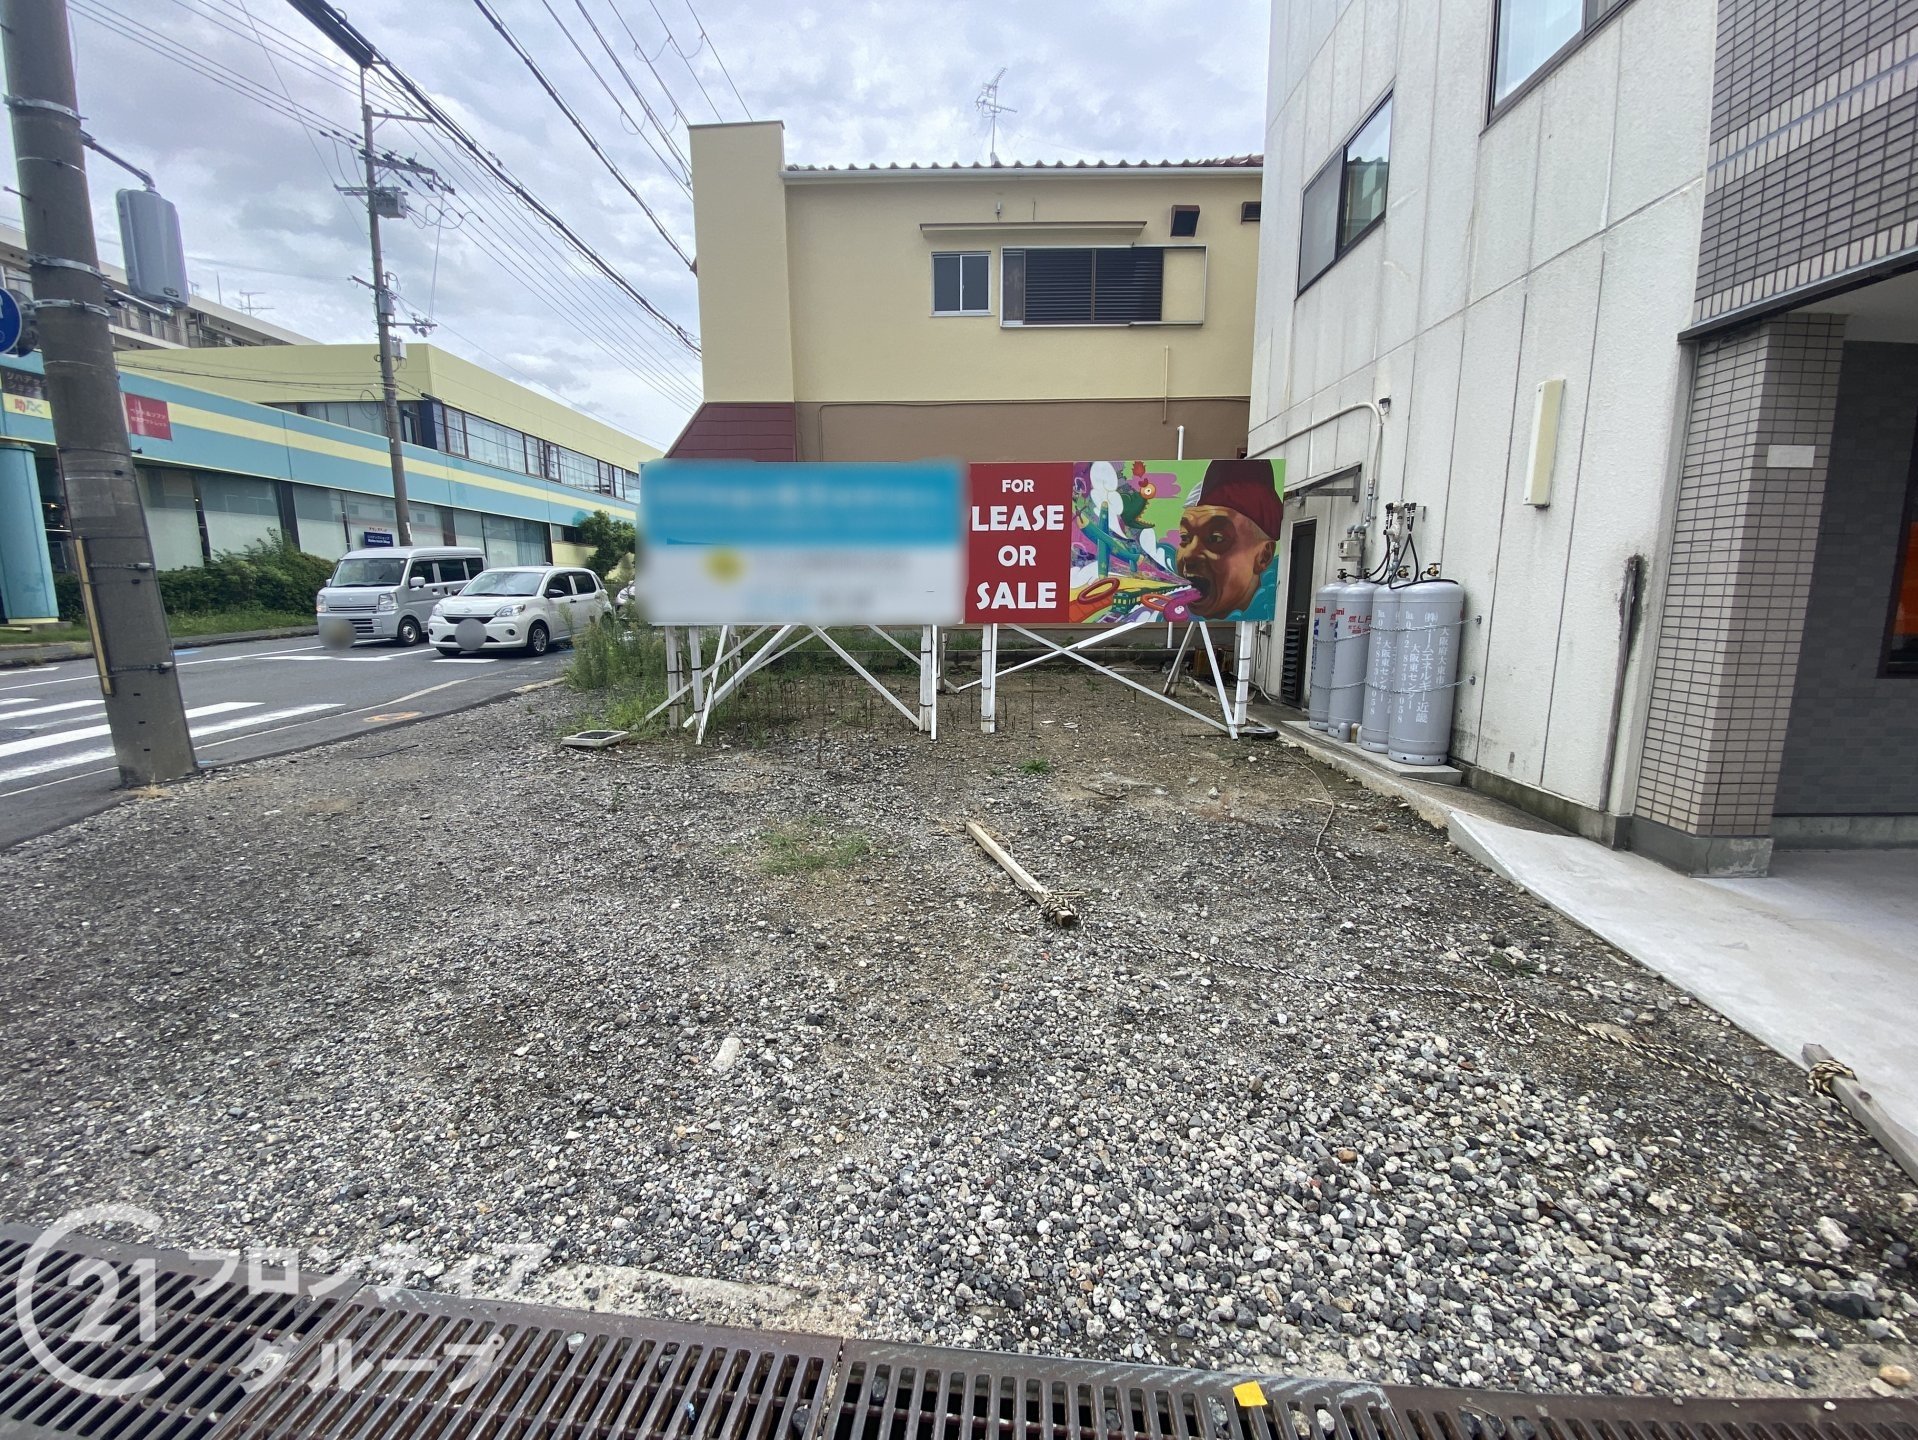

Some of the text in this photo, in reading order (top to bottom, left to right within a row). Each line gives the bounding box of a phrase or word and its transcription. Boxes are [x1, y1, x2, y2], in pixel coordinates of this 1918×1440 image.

[1001, 479, 1035, 493] FOR
[971, 504, 1065, 532] LEASE
[998, 545, 1037, 567] OR
[976, 581, 1057, 610] SALE
[1407, 643, 1420, 710] 大阪東センター
